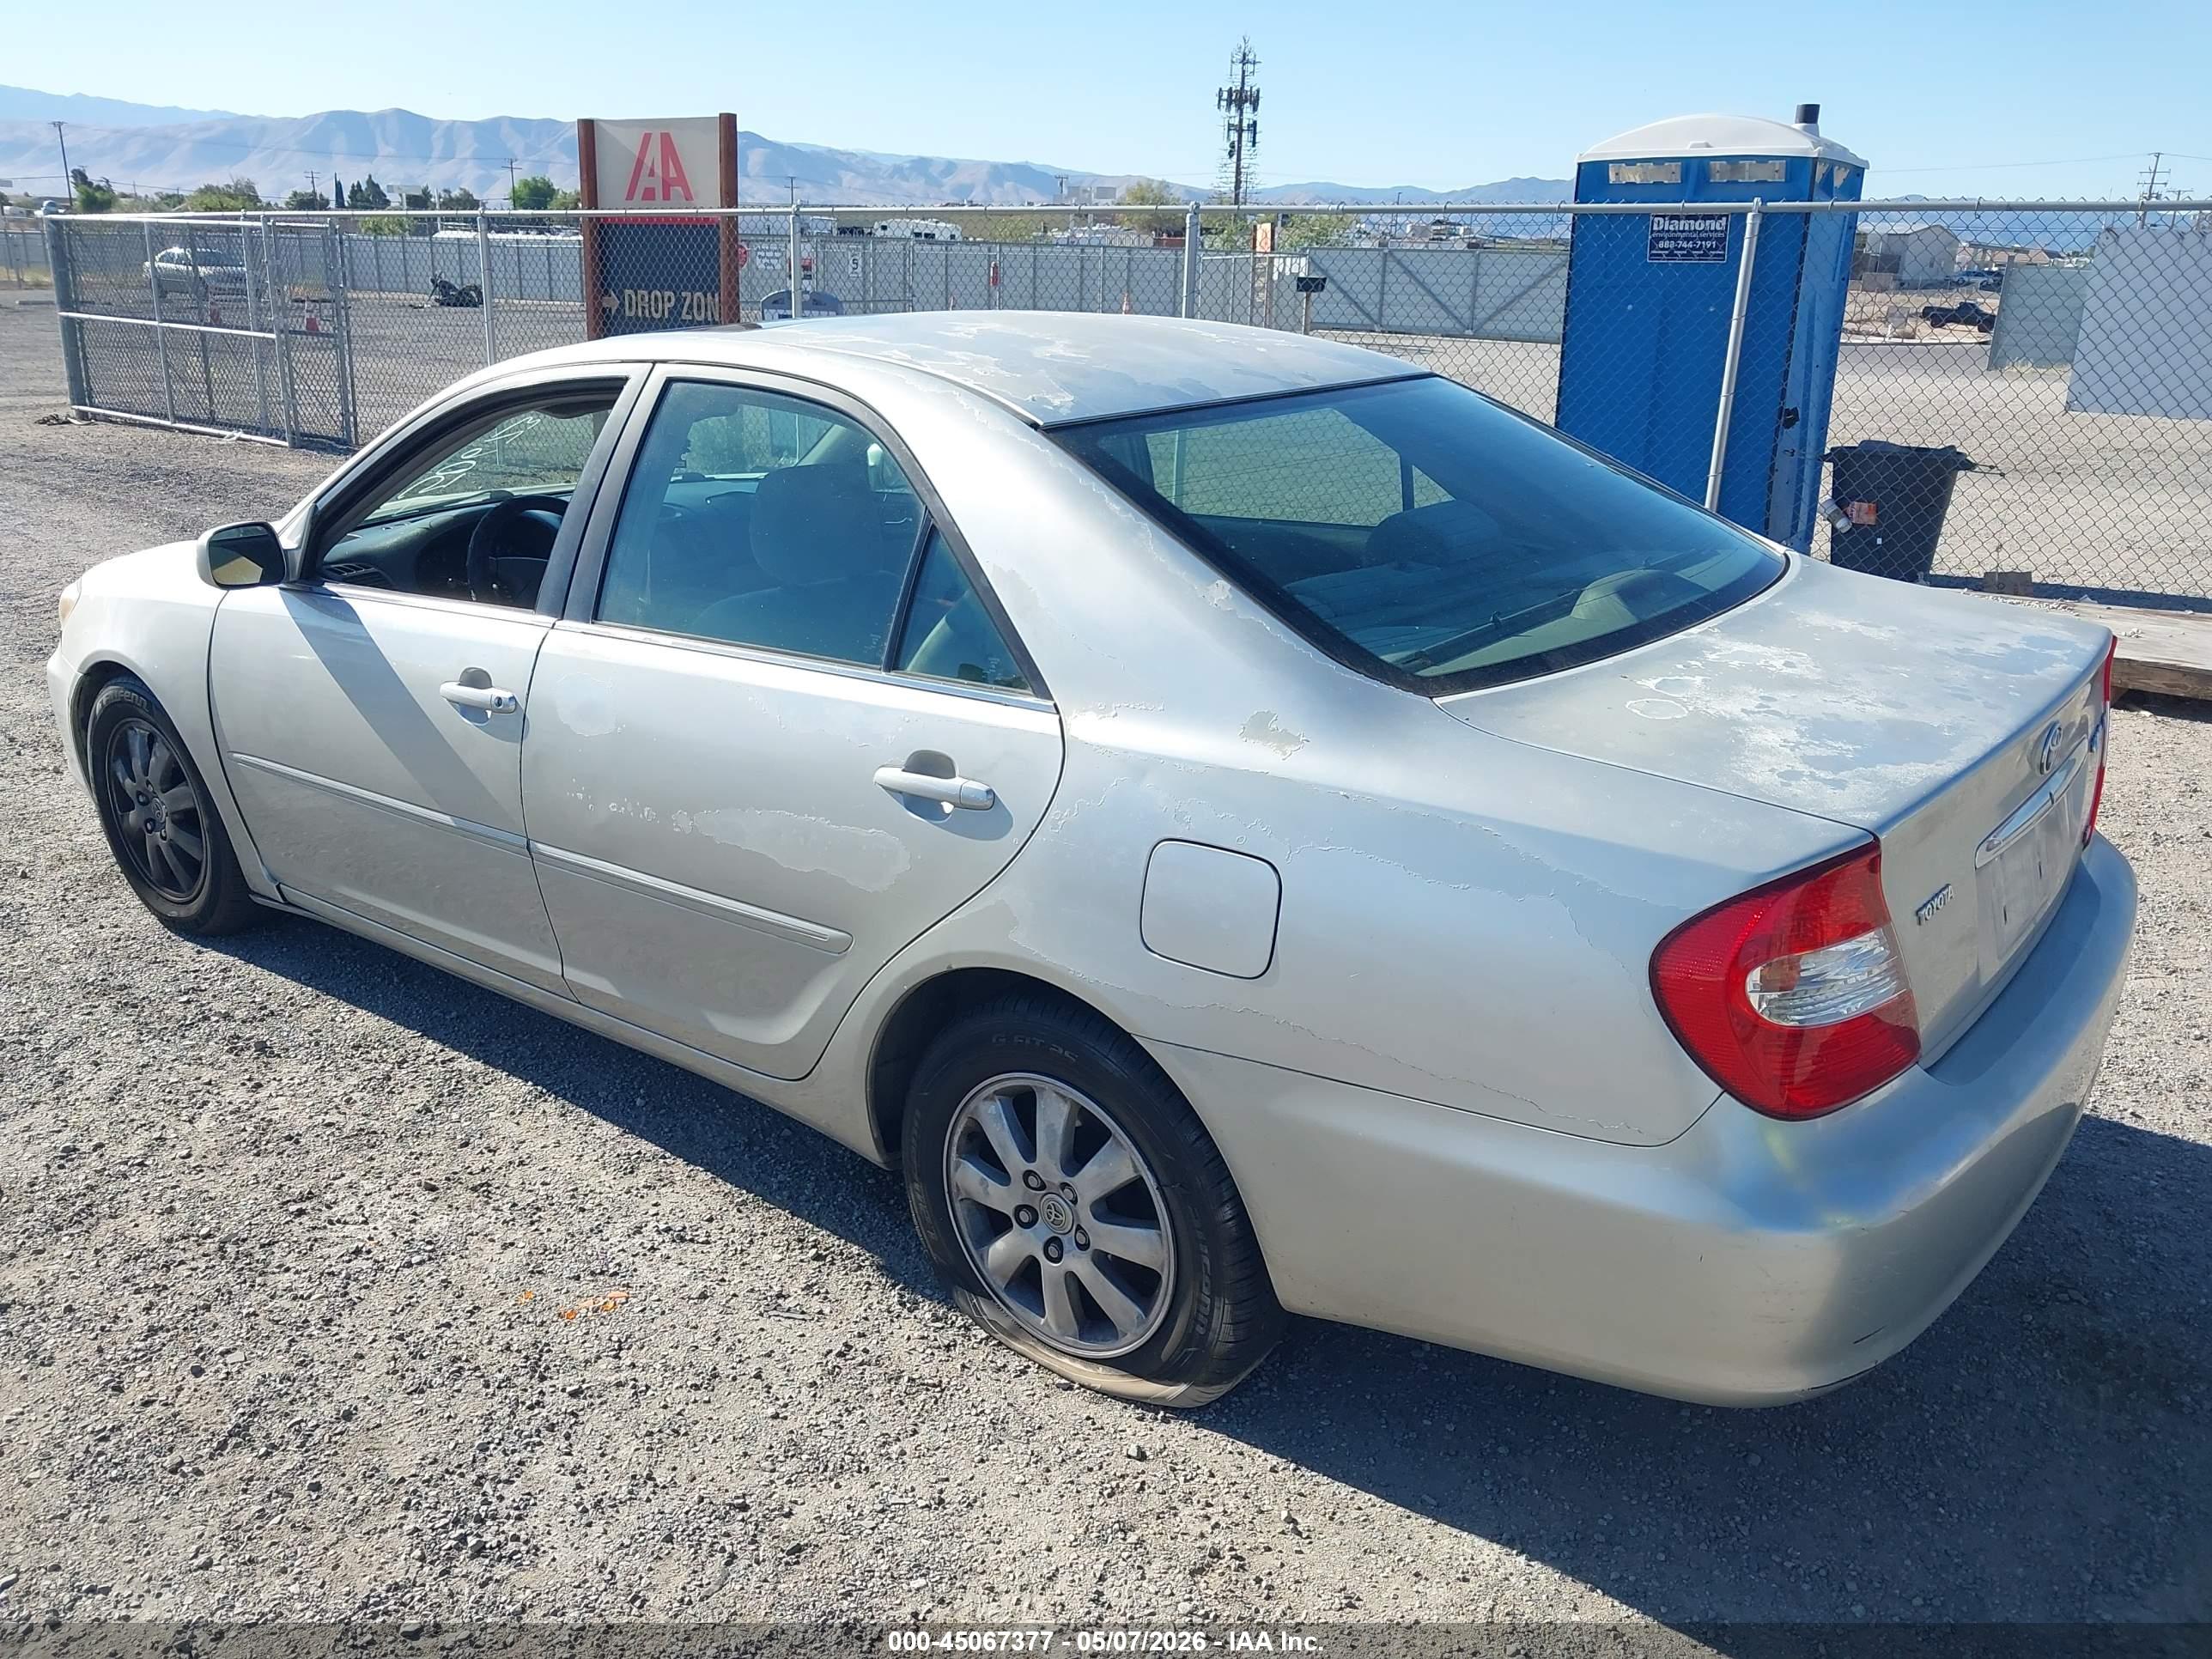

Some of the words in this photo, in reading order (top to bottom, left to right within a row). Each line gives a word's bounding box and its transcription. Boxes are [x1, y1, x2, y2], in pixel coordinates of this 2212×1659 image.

[1652, 216, 1727, 231] Diamond
[624, 289, 675, 319] DROP
[681, 291, 720, 322] ZON
[1916, 884, 1954, 926] TOYOTA
